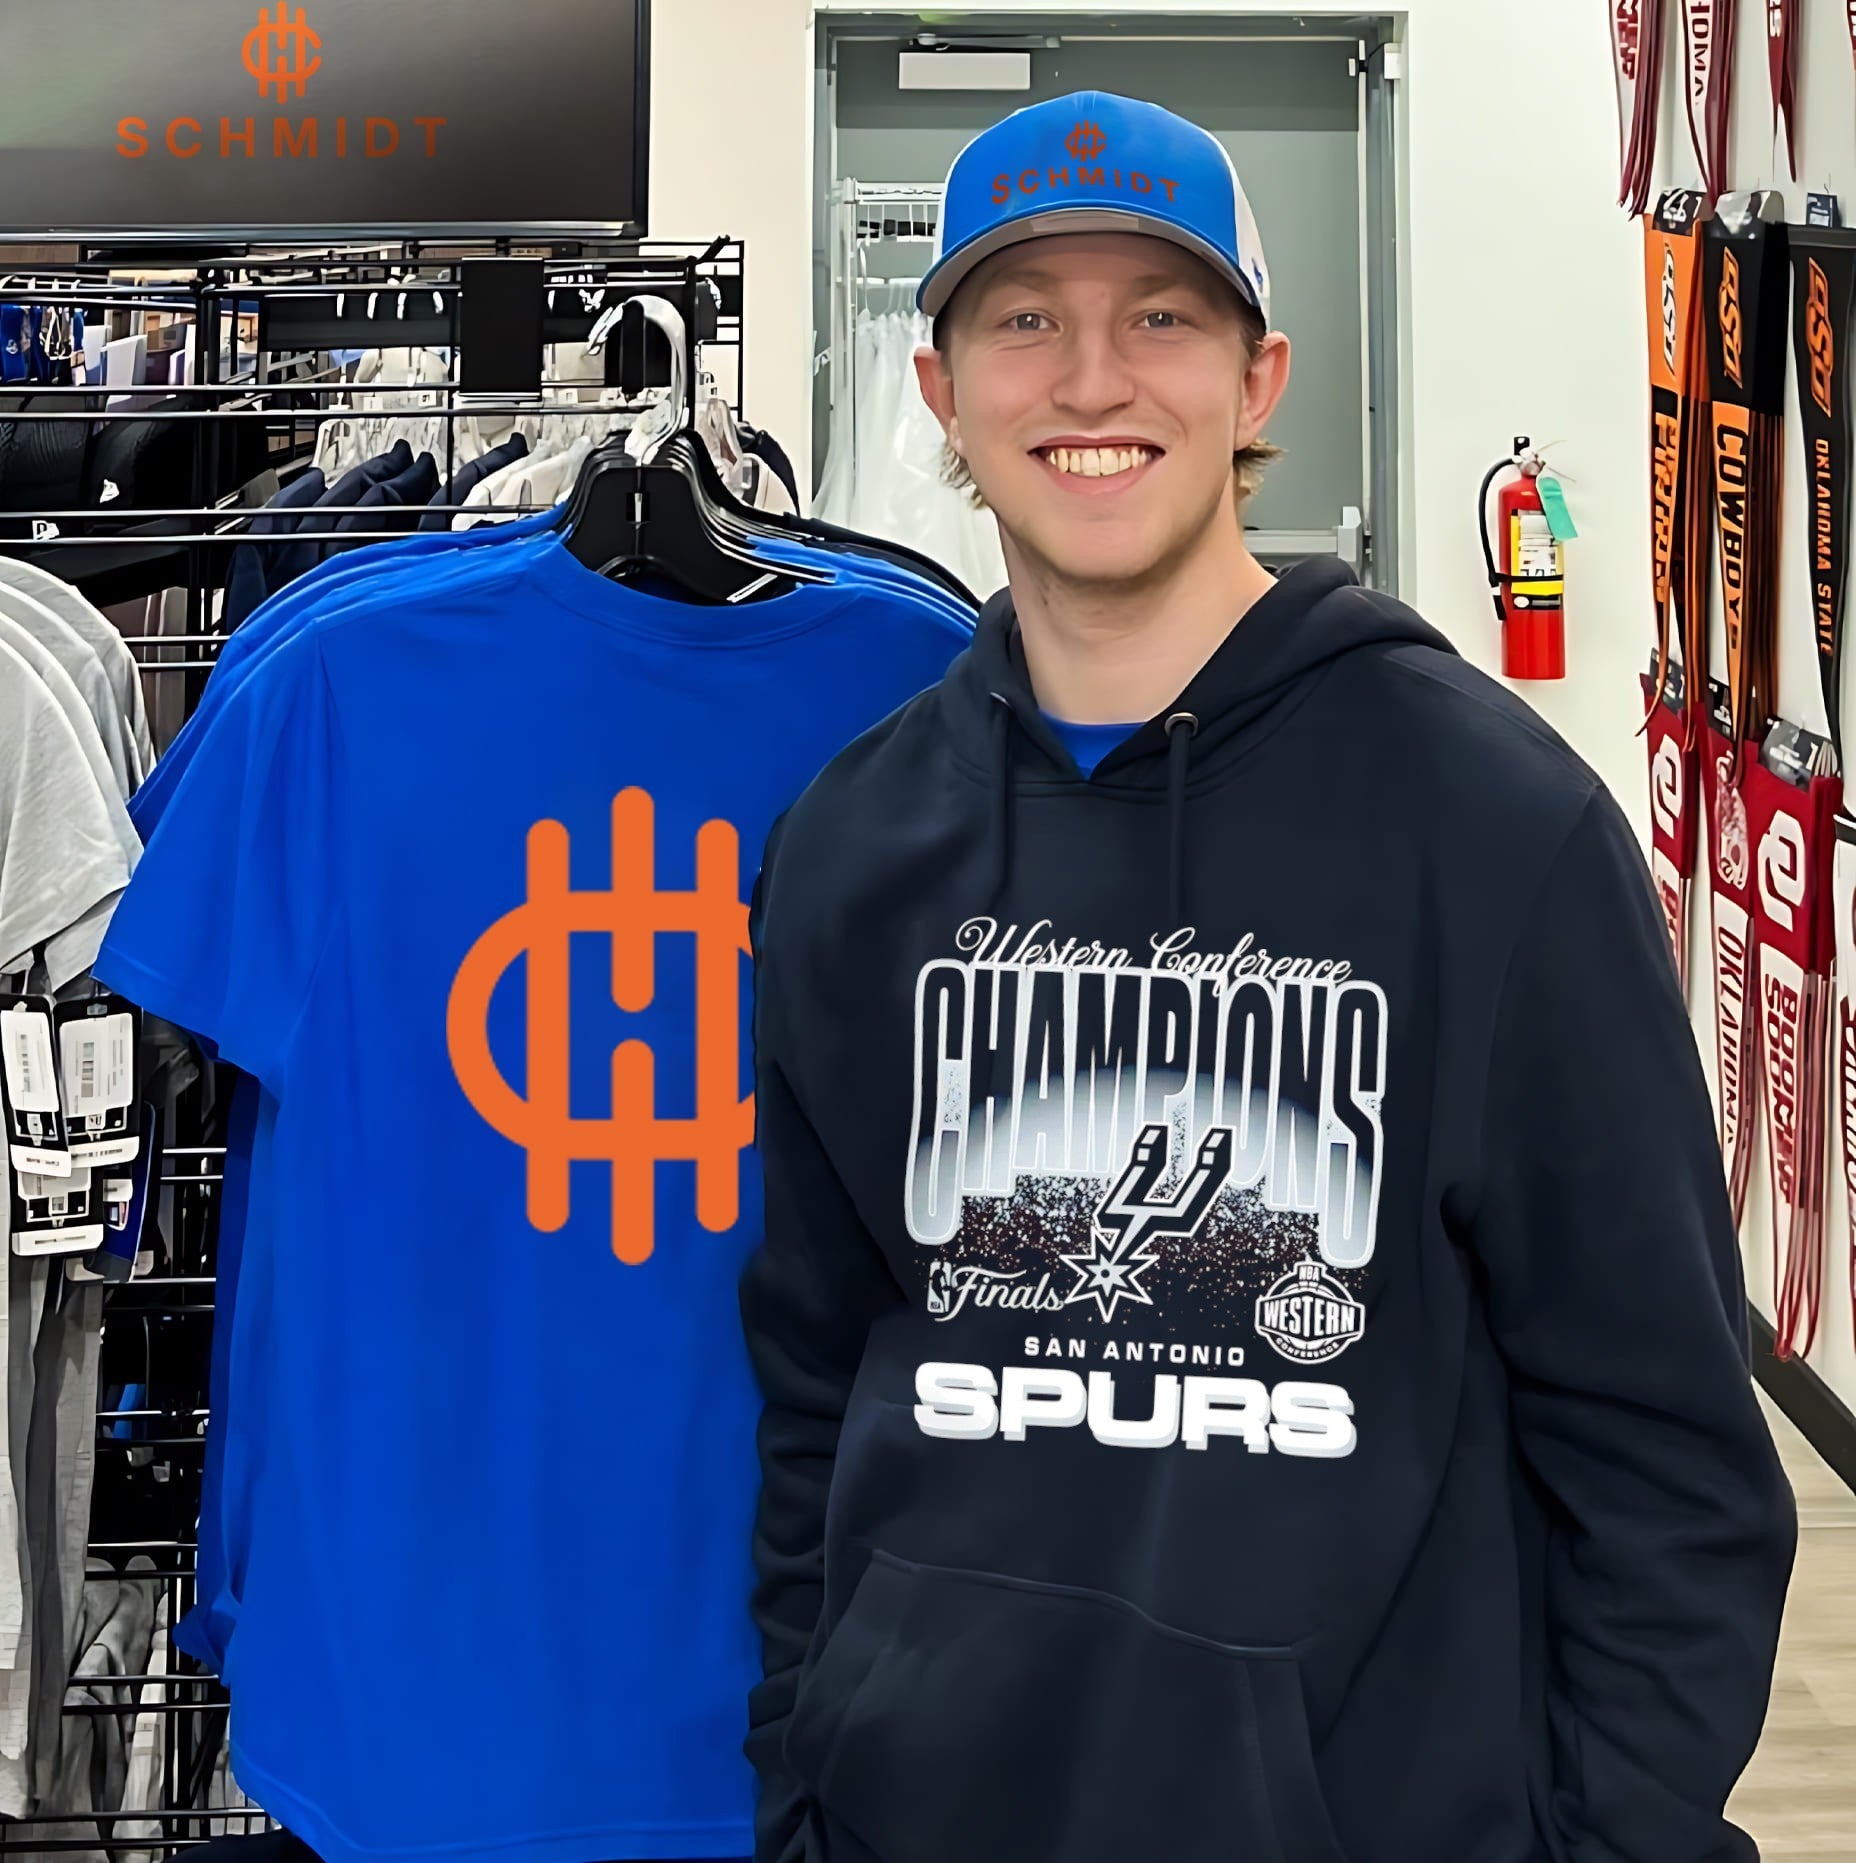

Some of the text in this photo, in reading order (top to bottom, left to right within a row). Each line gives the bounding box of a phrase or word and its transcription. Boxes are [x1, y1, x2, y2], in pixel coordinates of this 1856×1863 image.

[115, 116, 448, 159] SCHMIDT
[992, 166, 1180, 205] SCHMIDT
[1815, 438, 1833, 571] OKLAHOMA
[955, 917, 1353, 998] Western Conference
[904, 958, 1388, 1269] CHAMPIONS
[934, 1265, 1065, 1322] Finals
[1298, 1265, 1320, 1281] NBA
[1263, 1296, 1356, 1338] WESTERN
[1023, 1335, 1246, 1367] SAN ANTONIO
[1275, 1337, 1340, 1358] CONFERENCE
[913, 1361, 1358, 1459] SPURS
